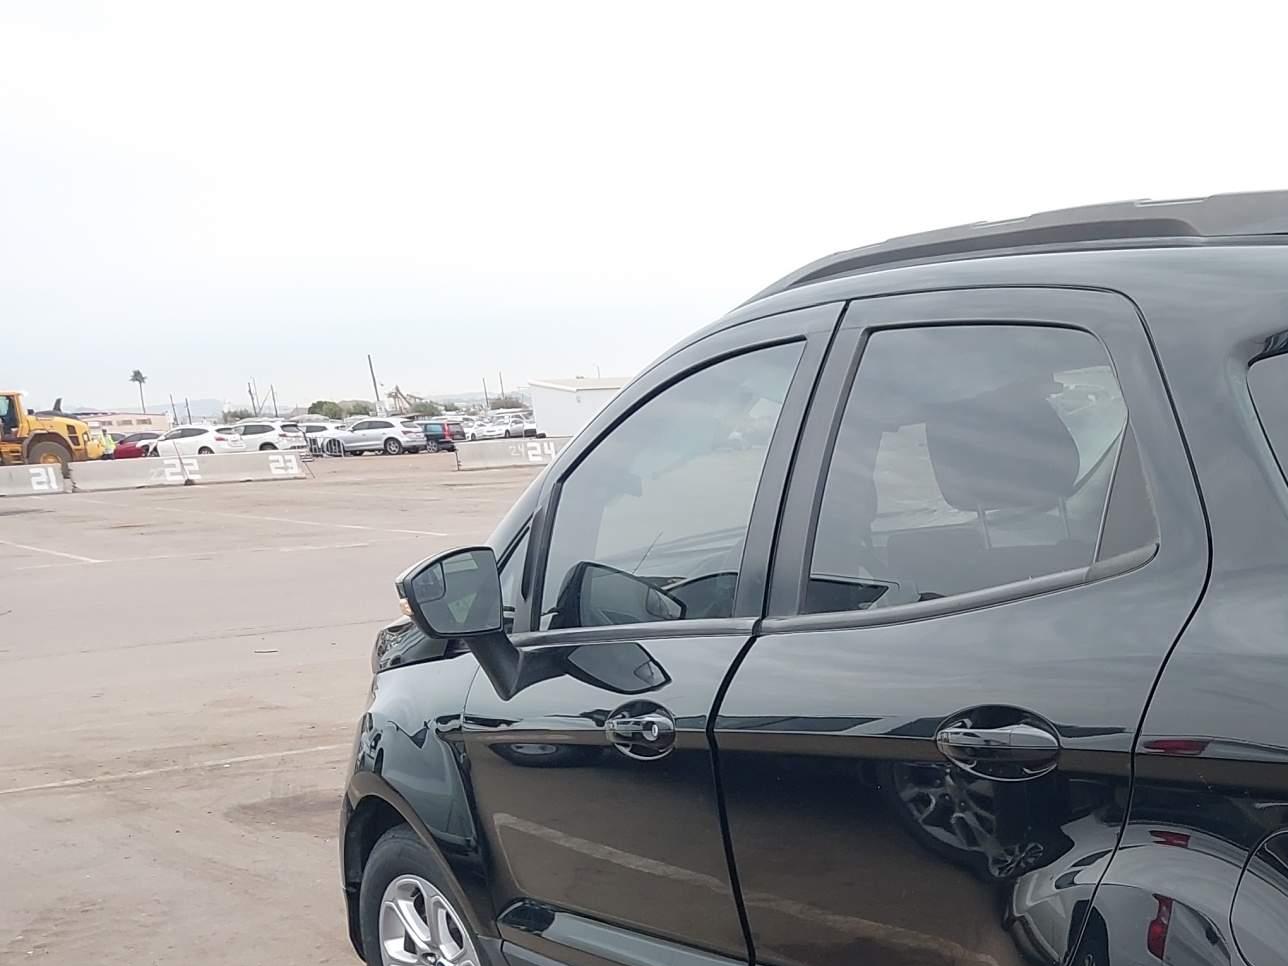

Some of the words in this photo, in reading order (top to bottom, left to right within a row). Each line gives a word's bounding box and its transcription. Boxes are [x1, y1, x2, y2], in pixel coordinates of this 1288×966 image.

[526, 441, 556, 462] 24
[163, 458, 202, 481] 22
[268, 454, 299, 475] 23
[29, 466, 58, 490] 21
